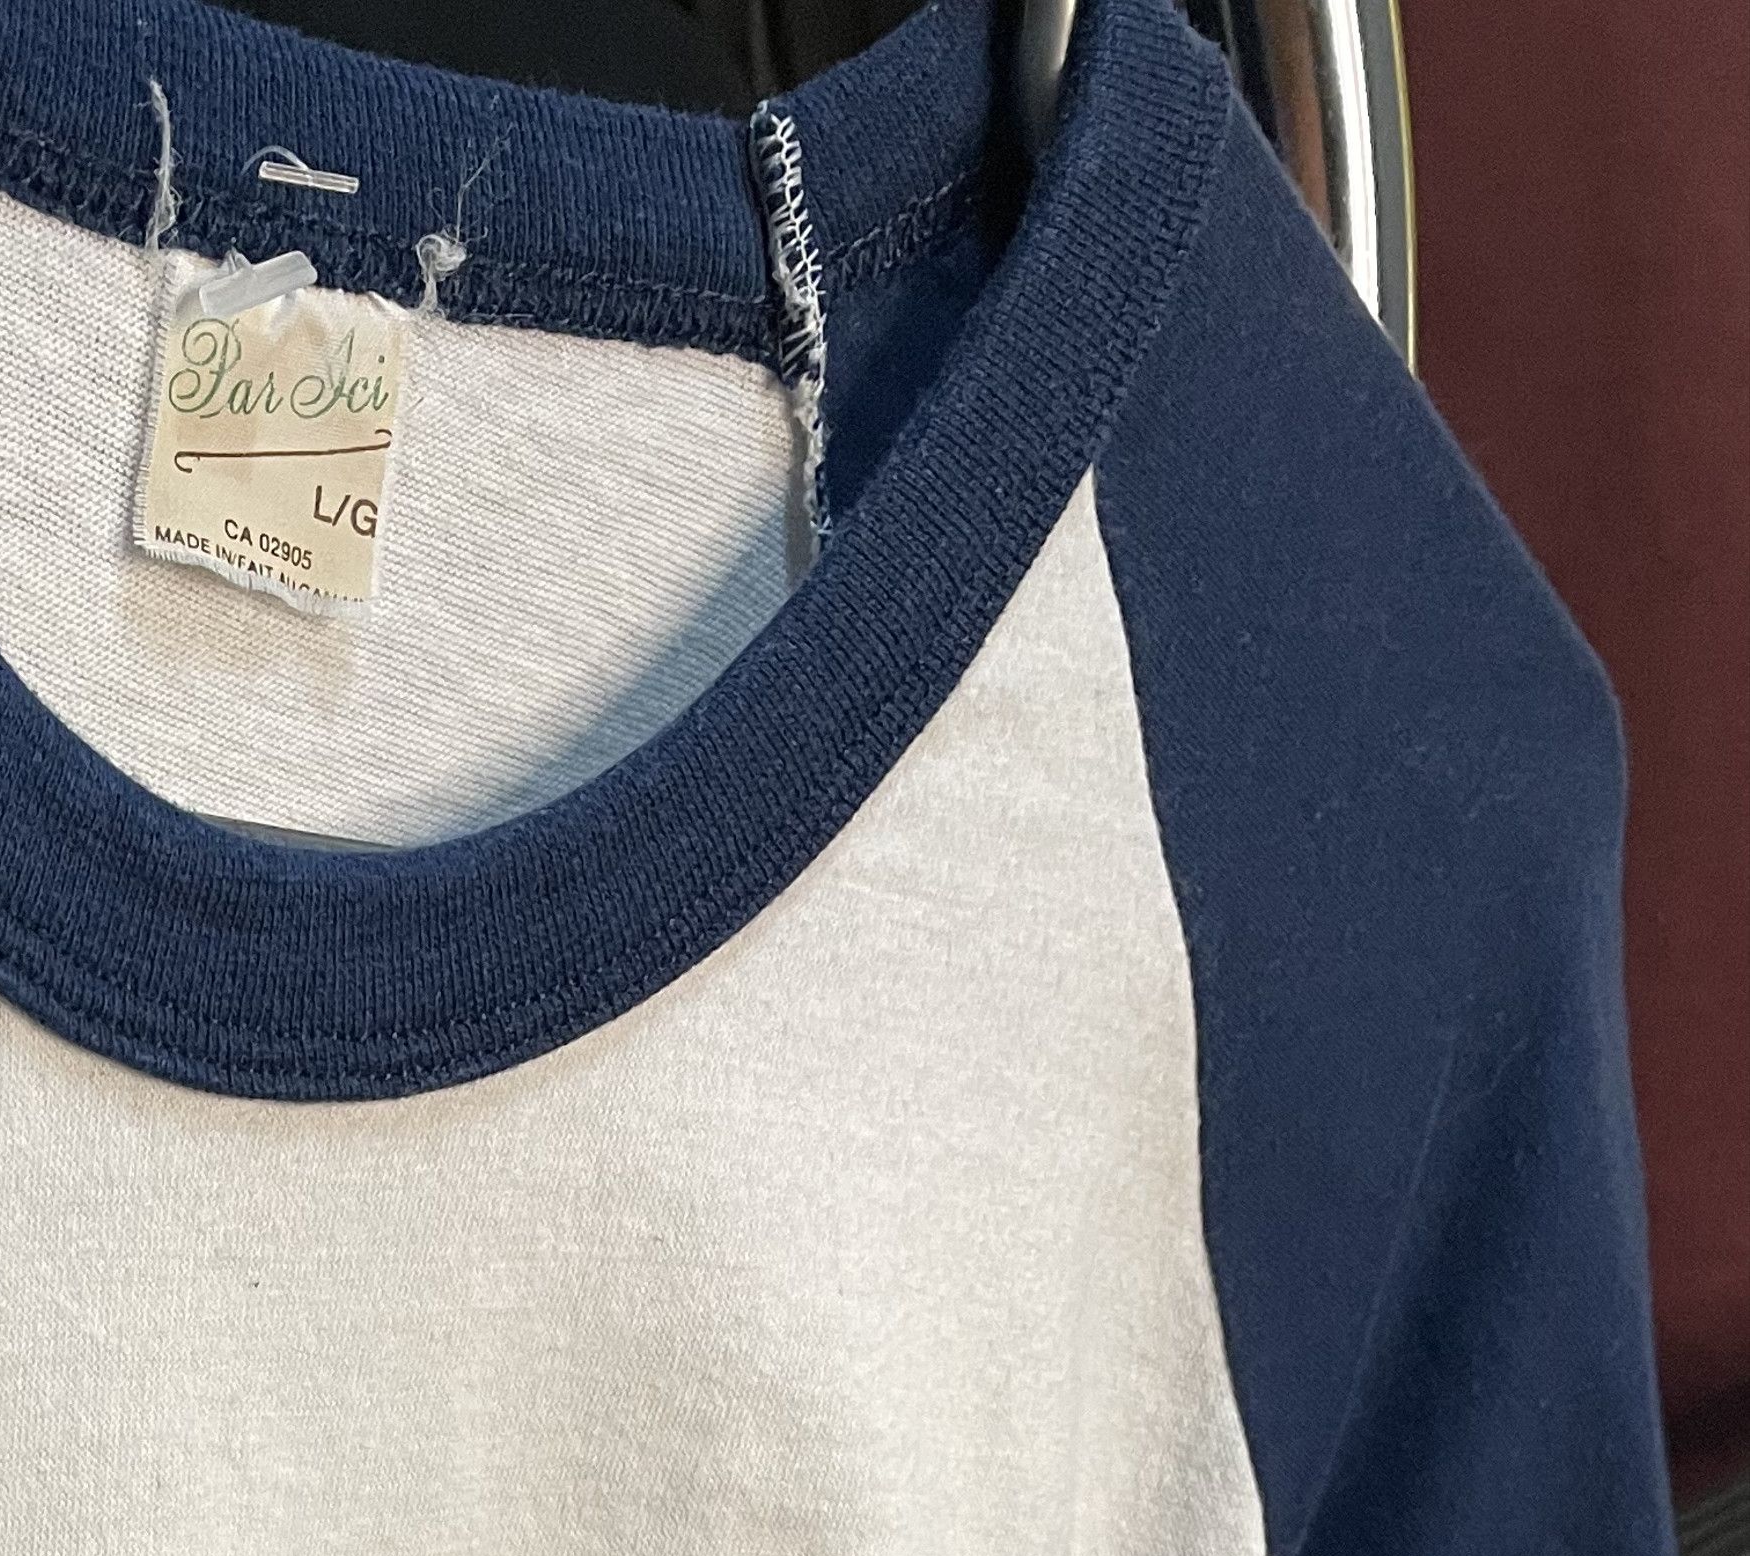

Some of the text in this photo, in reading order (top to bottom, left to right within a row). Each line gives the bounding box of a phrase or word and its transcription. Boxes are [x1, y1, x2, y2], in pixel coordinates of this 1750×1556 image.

[168, 317, 284, 420] Par
[312, 484, 379, 539] L/G
[154, 525, 212, 555] MADE
[223, 518, 313, 571] CA 02905
